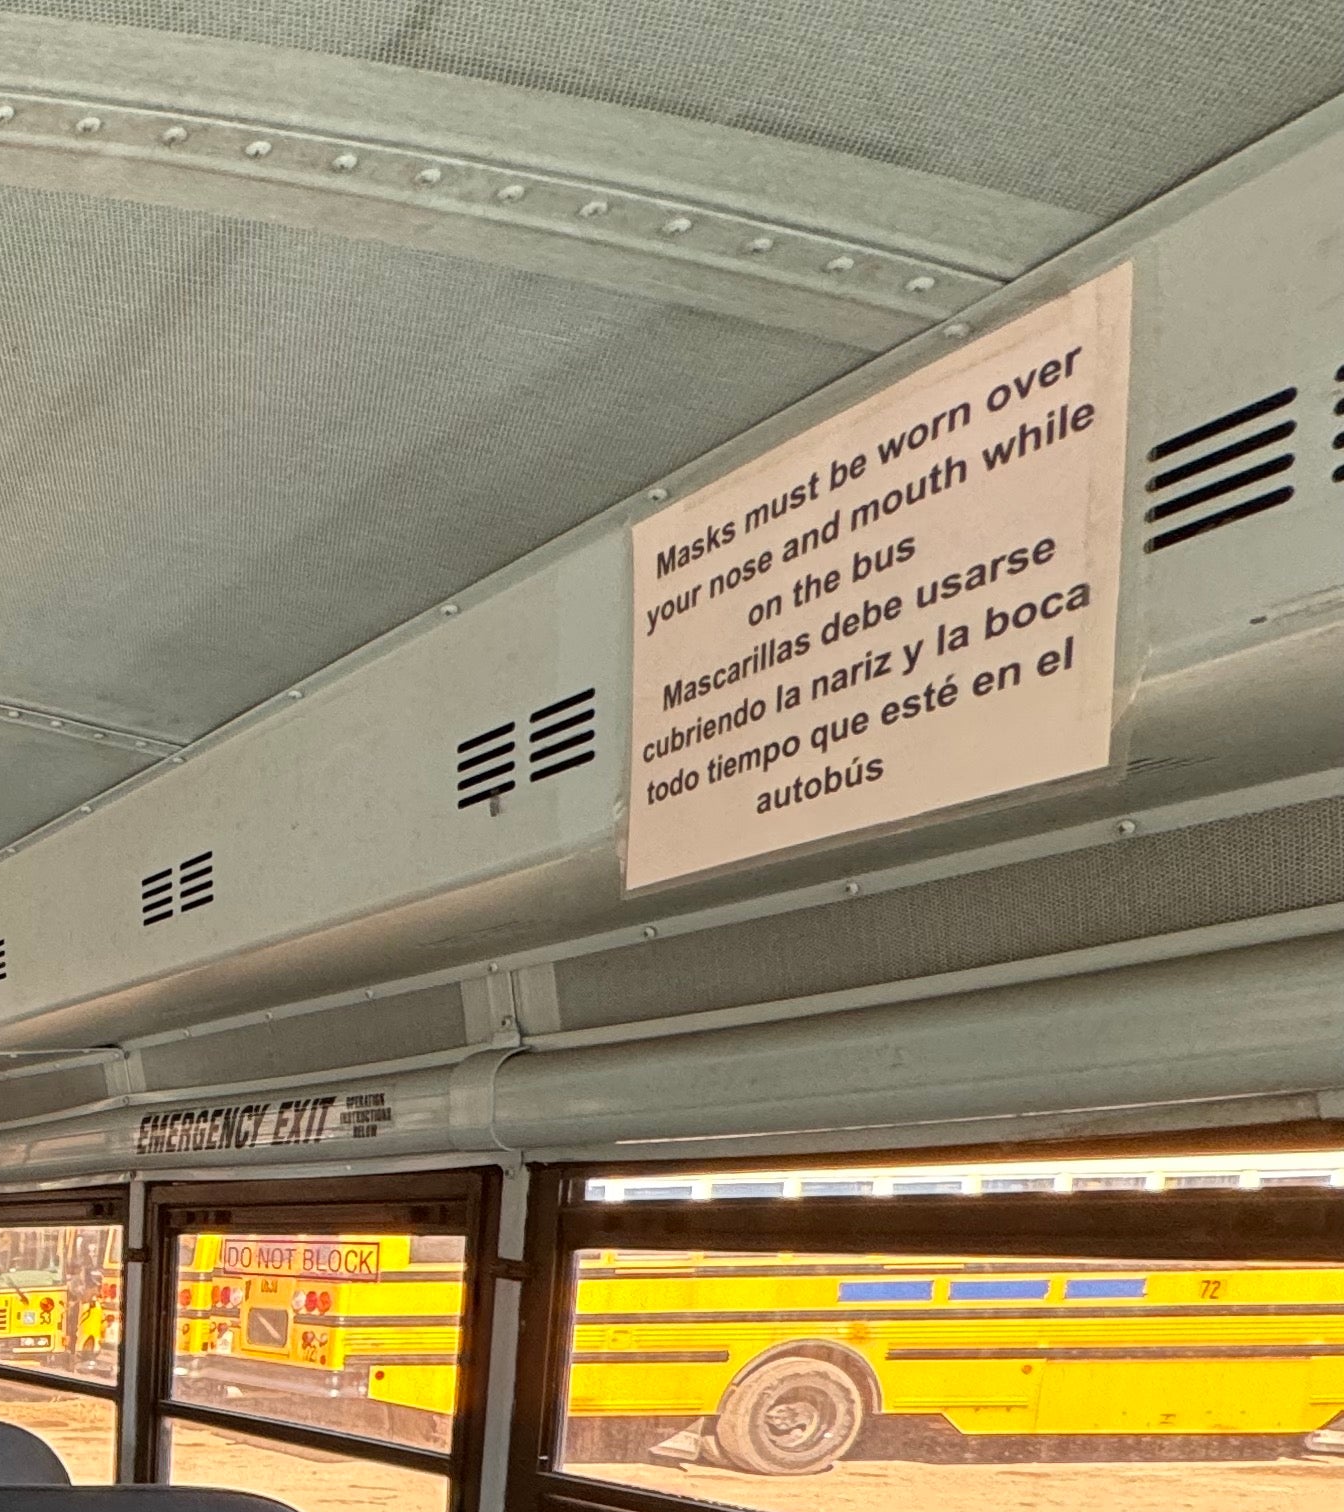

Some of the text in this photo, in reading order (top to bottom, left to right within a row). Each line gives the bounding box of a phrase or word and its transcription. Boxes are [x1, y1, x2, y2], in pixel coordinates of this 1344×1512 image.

[646, 402, 1096, 637] your nose and mouth while
[655, 345, 1083, 580] Masks must be worn over
[662, 536, 1057, 712] Mascarillas debe usarse
[747, 535, 916, 627] on the bus
[642, 581, 1091, 764] cubriendo la nariz y la boca
[646, 635, 1075, 806] todo tiempo que esté en el
[756, 756, 885, 815] autobús
[135, 1095, 338, 1155] EMERGENCY EXIT
[227, 1246, 375, 1275] DO NOT BLOCK
[1200, 1279, 1222, 1300] 72
